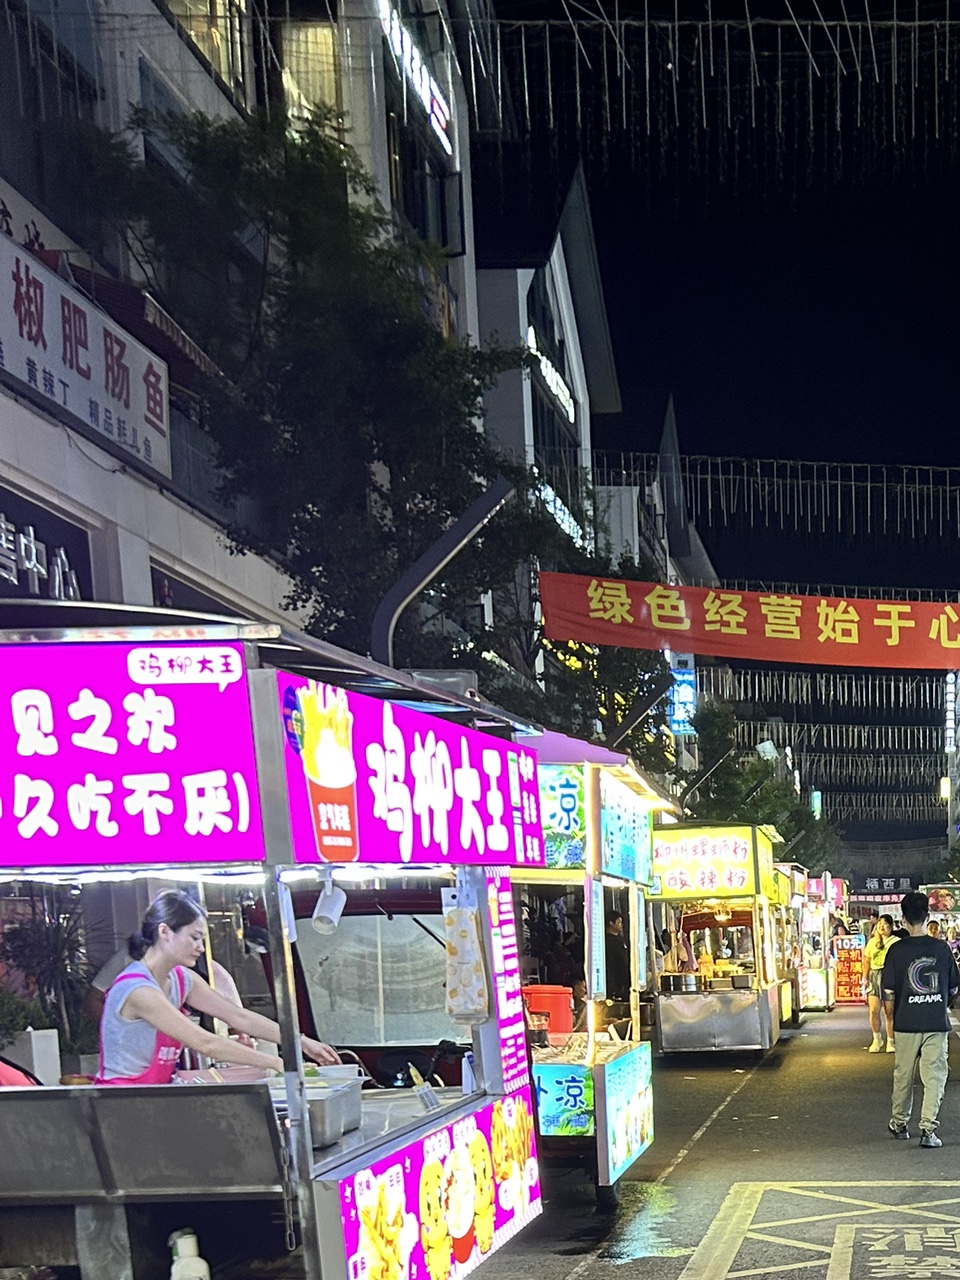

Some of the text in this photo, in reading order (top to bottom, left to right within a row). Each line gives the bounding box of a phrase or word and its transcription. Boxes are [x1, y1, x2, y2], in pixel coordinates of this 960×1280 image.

[11, 256, 166, 438] 椒肥肠鱼
[138, 653, 235, 677] 鸡柳大王
[11, 688, 177, 756] 见之欢
[366, 701, 509, 862] 鸡柳大王
[654, 838, 748, 860] 柳州螺蛳粉
[668, 870, 745, 890] 酸辣粉
[837, 938, 862, 949] 10元
